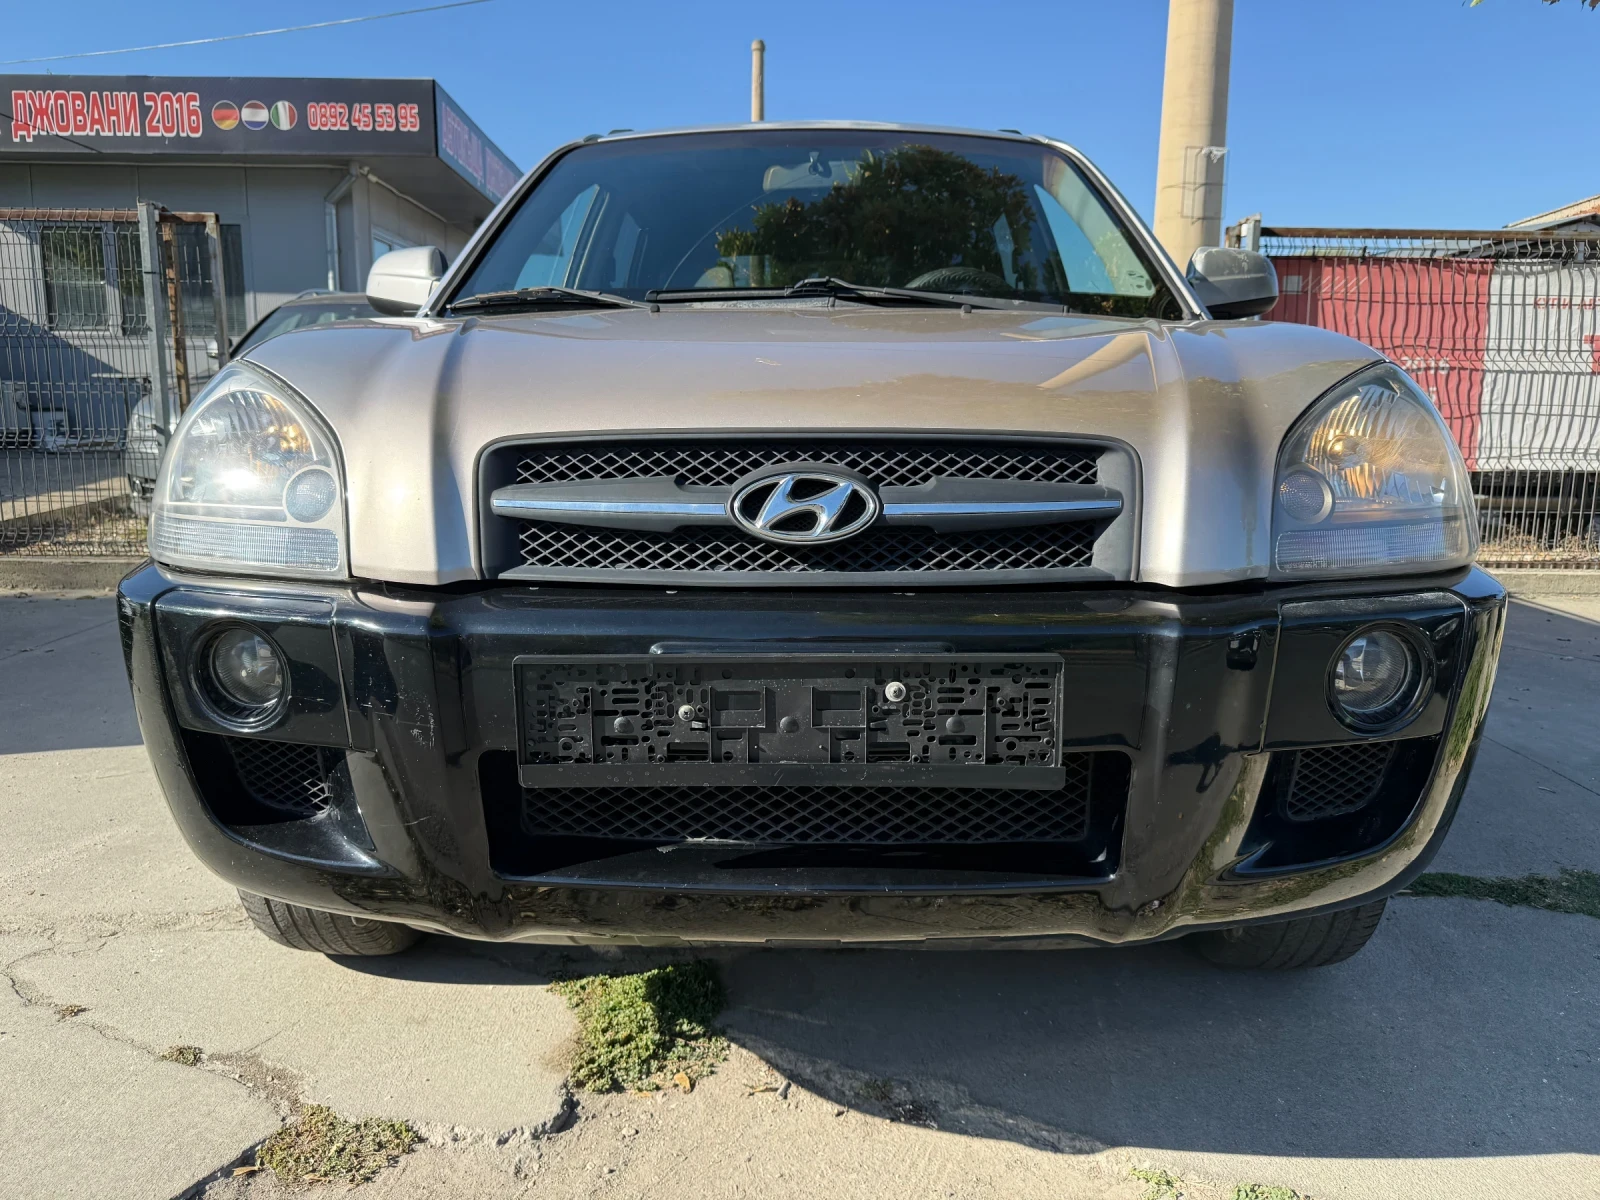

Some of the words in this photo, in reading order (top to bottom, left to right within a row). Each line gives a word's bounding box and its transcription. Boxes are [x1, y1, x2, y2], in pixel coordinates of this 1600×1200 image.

[11, 90, 140, 142] ДЖОВАНИ
[144, 92, 202, 137] 2016
[307, 101, 349, 131] 0892
[352, 102, 373, 131] 45
[374, 103, 397, 132] 53
[397, 104, 420, 132] 95
